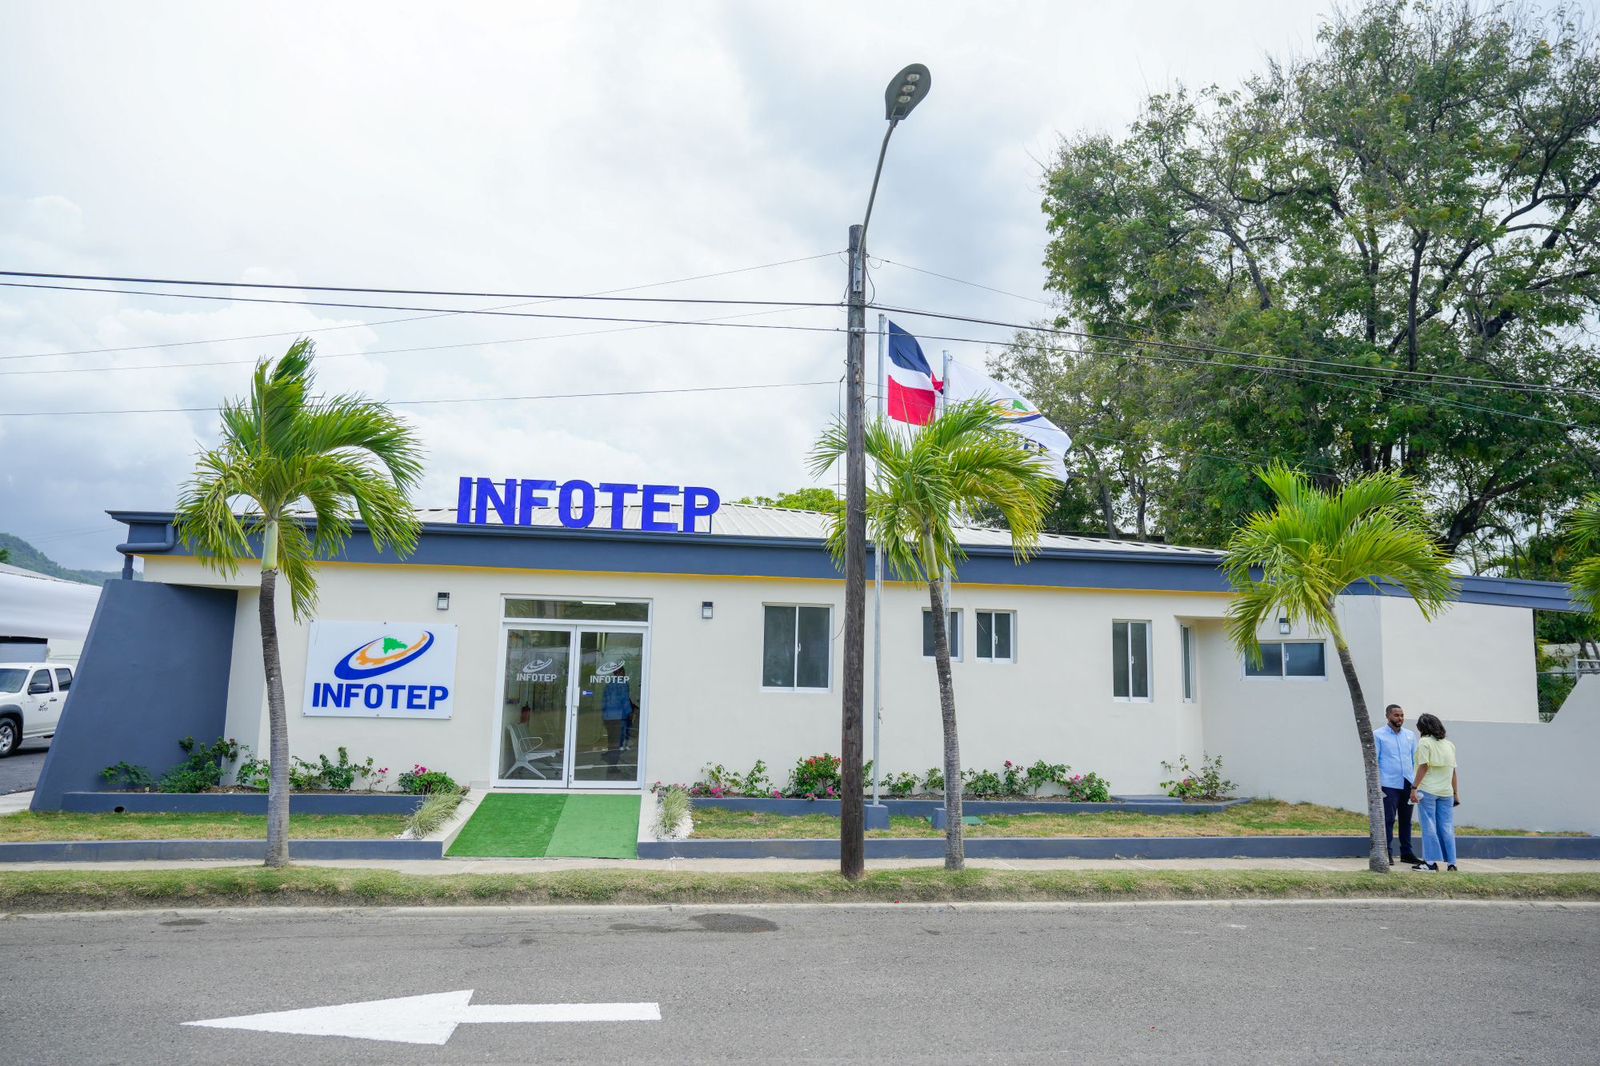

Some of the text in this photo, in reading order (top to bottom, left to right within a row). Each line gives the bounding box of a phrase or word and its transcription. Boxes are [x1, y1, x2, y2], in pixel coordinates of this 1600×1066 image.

[457, 477, 720, 533] INFOTEP
[516, 673, 557, 682] INFOTEP
[589, 675, 630, 684] INFOTEP
[312, 682, 449, 710] INFOTEP
